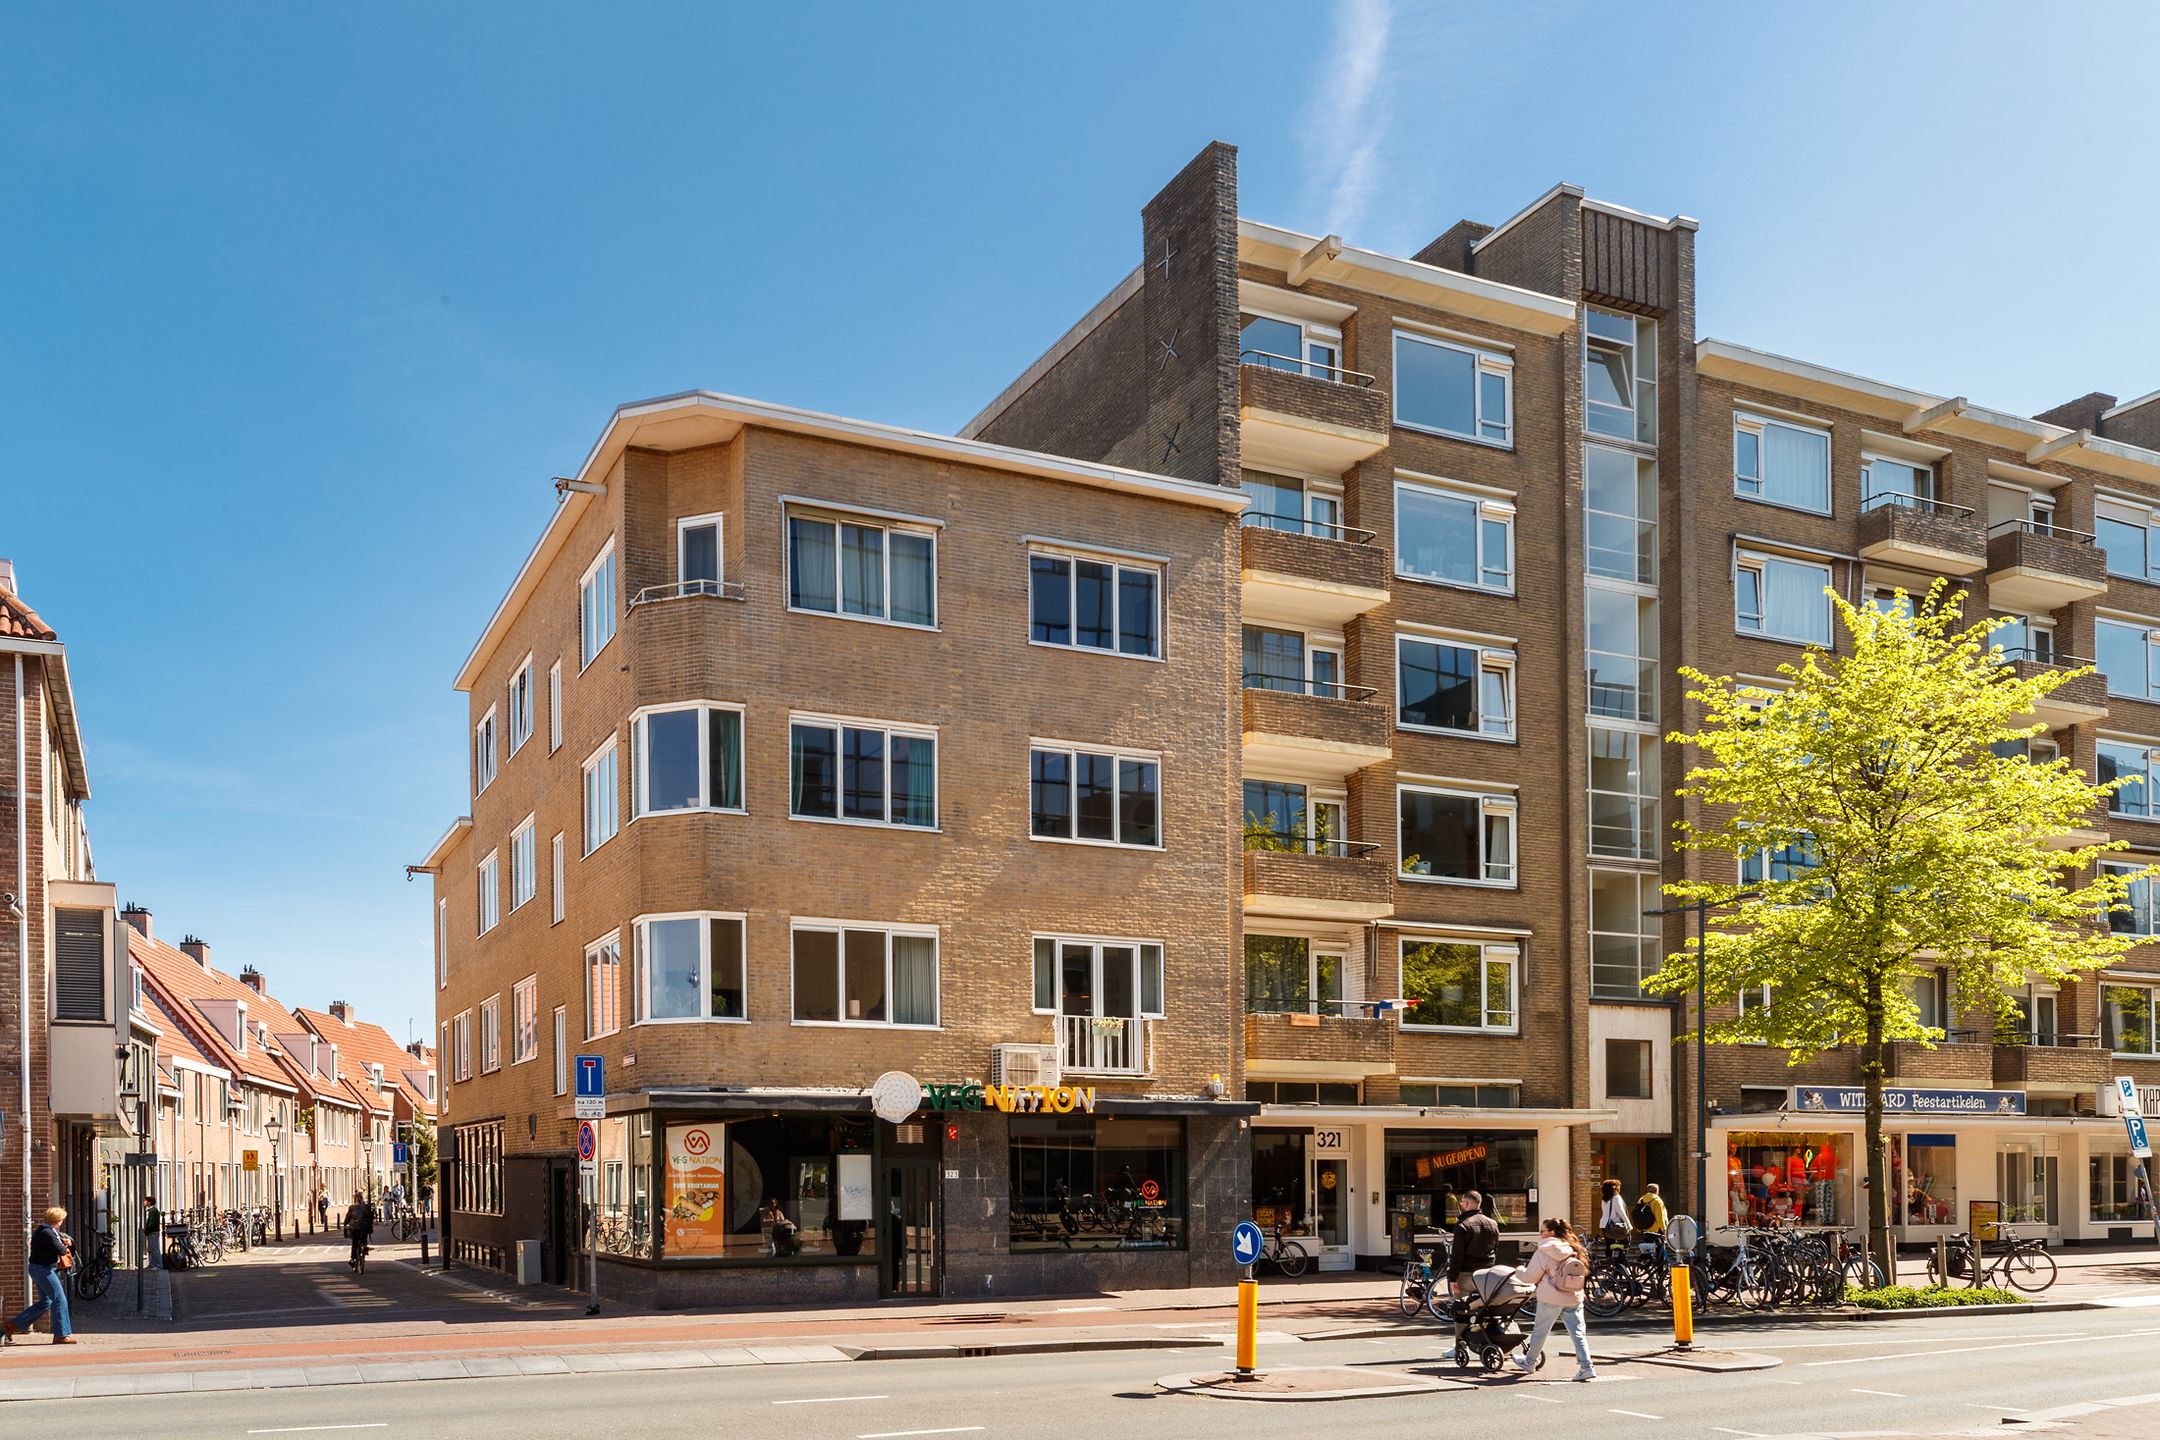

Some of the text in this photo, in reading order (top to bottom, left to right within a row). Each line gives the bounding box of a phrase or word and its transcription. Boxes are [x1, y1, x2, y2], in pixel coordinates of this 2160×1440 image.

[925, 1082, 1096, 1114] VEG NATION
[1912, 1093, 1986, 1109] Feestartikelen
[1317, 1132, 1341, 1148] 321
[672, 1156, 722, 1164] VEG NATION
[1432, 1156, 1446, 1169] NU
